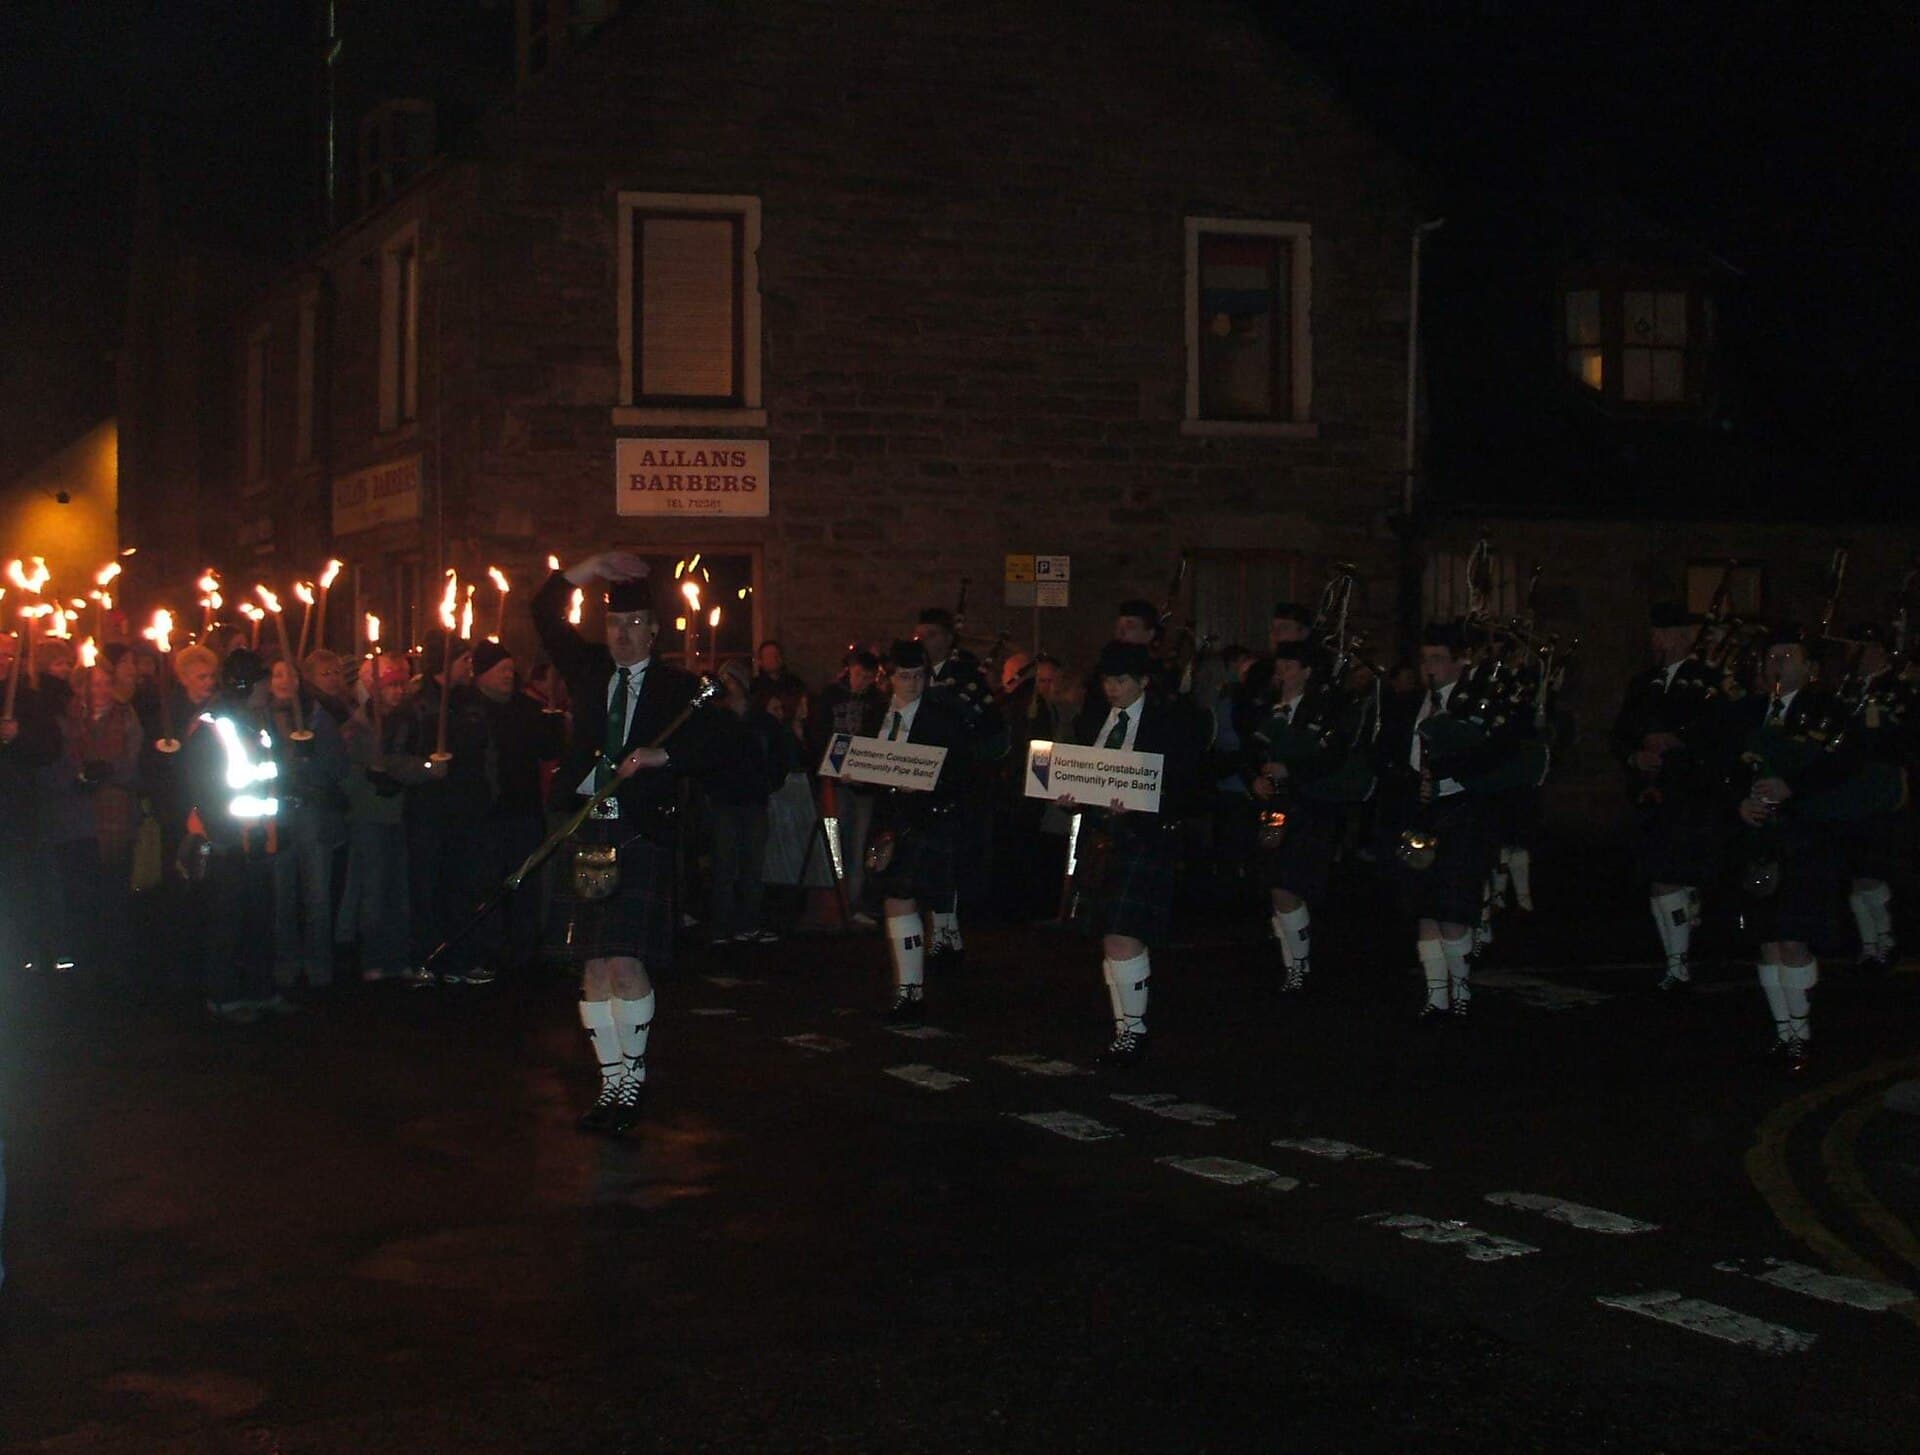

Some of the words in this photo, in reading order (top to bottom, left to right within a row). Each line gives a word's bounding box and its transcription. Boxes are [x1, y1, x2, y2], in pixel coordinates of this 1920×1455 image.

[640, 450, 746, 467] ALLANS
[630, 474, 757, 492] BARBERS
[667, 499, 684, 508] TEL
[1054, 757, 1094, 770] Northern
[1096, 761, 1159, 779] Constabulary
[1055, 771, 1106, 787] Community
[1108, 776, 1129, 788] Pipe
[1131, 780, 1156, 791] Band
